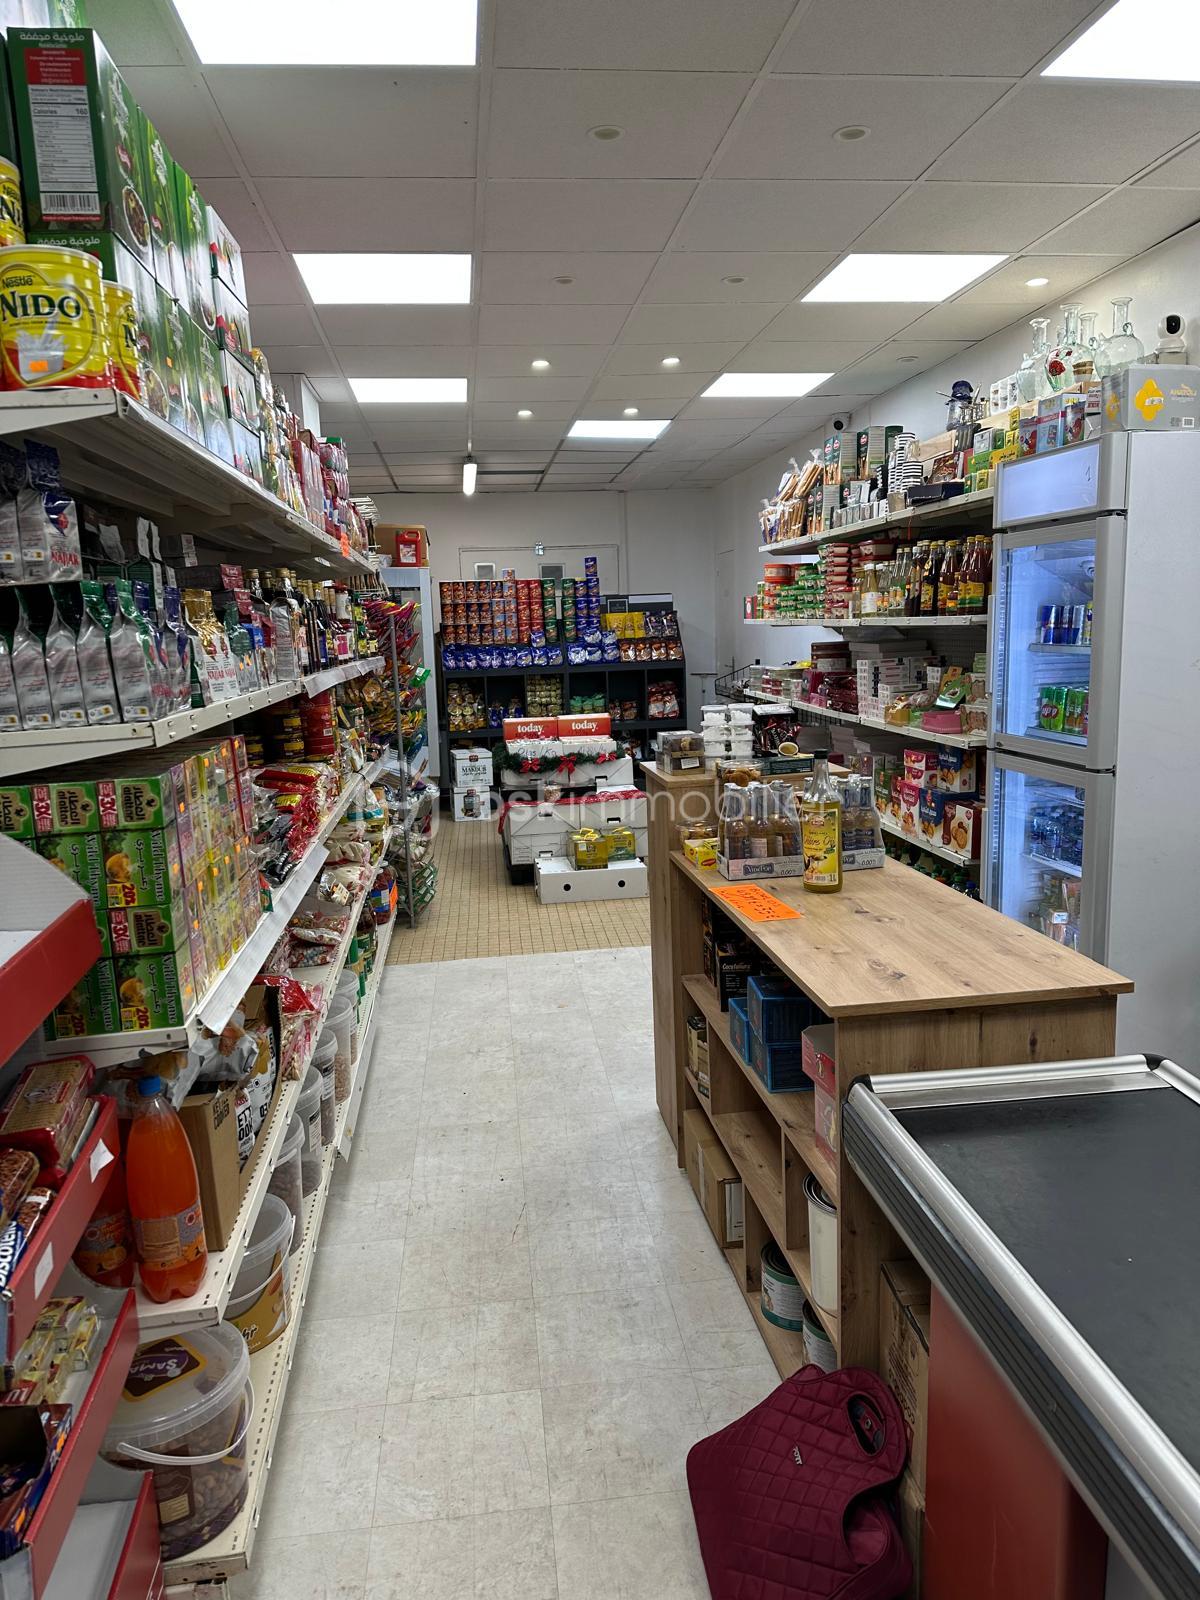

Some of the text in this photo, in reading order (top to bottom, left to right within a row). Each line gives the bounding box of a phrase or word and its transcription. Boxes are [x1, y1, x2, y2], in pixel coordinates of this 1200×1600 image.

[0, 291, 82, 322] NIDO
[517, 723, 544, 734] today
[571, 720, 598, 731] today
[35, 801, 52, 818] 3X
[100, 796, 117, 813] 3X
[86, 834, 99, 862] Wild
[151, 830, 166, 901] Wild Thyme
[113, 924, 130, 940] 3X
[162, 954, 178, 1024] Wild Thyme
